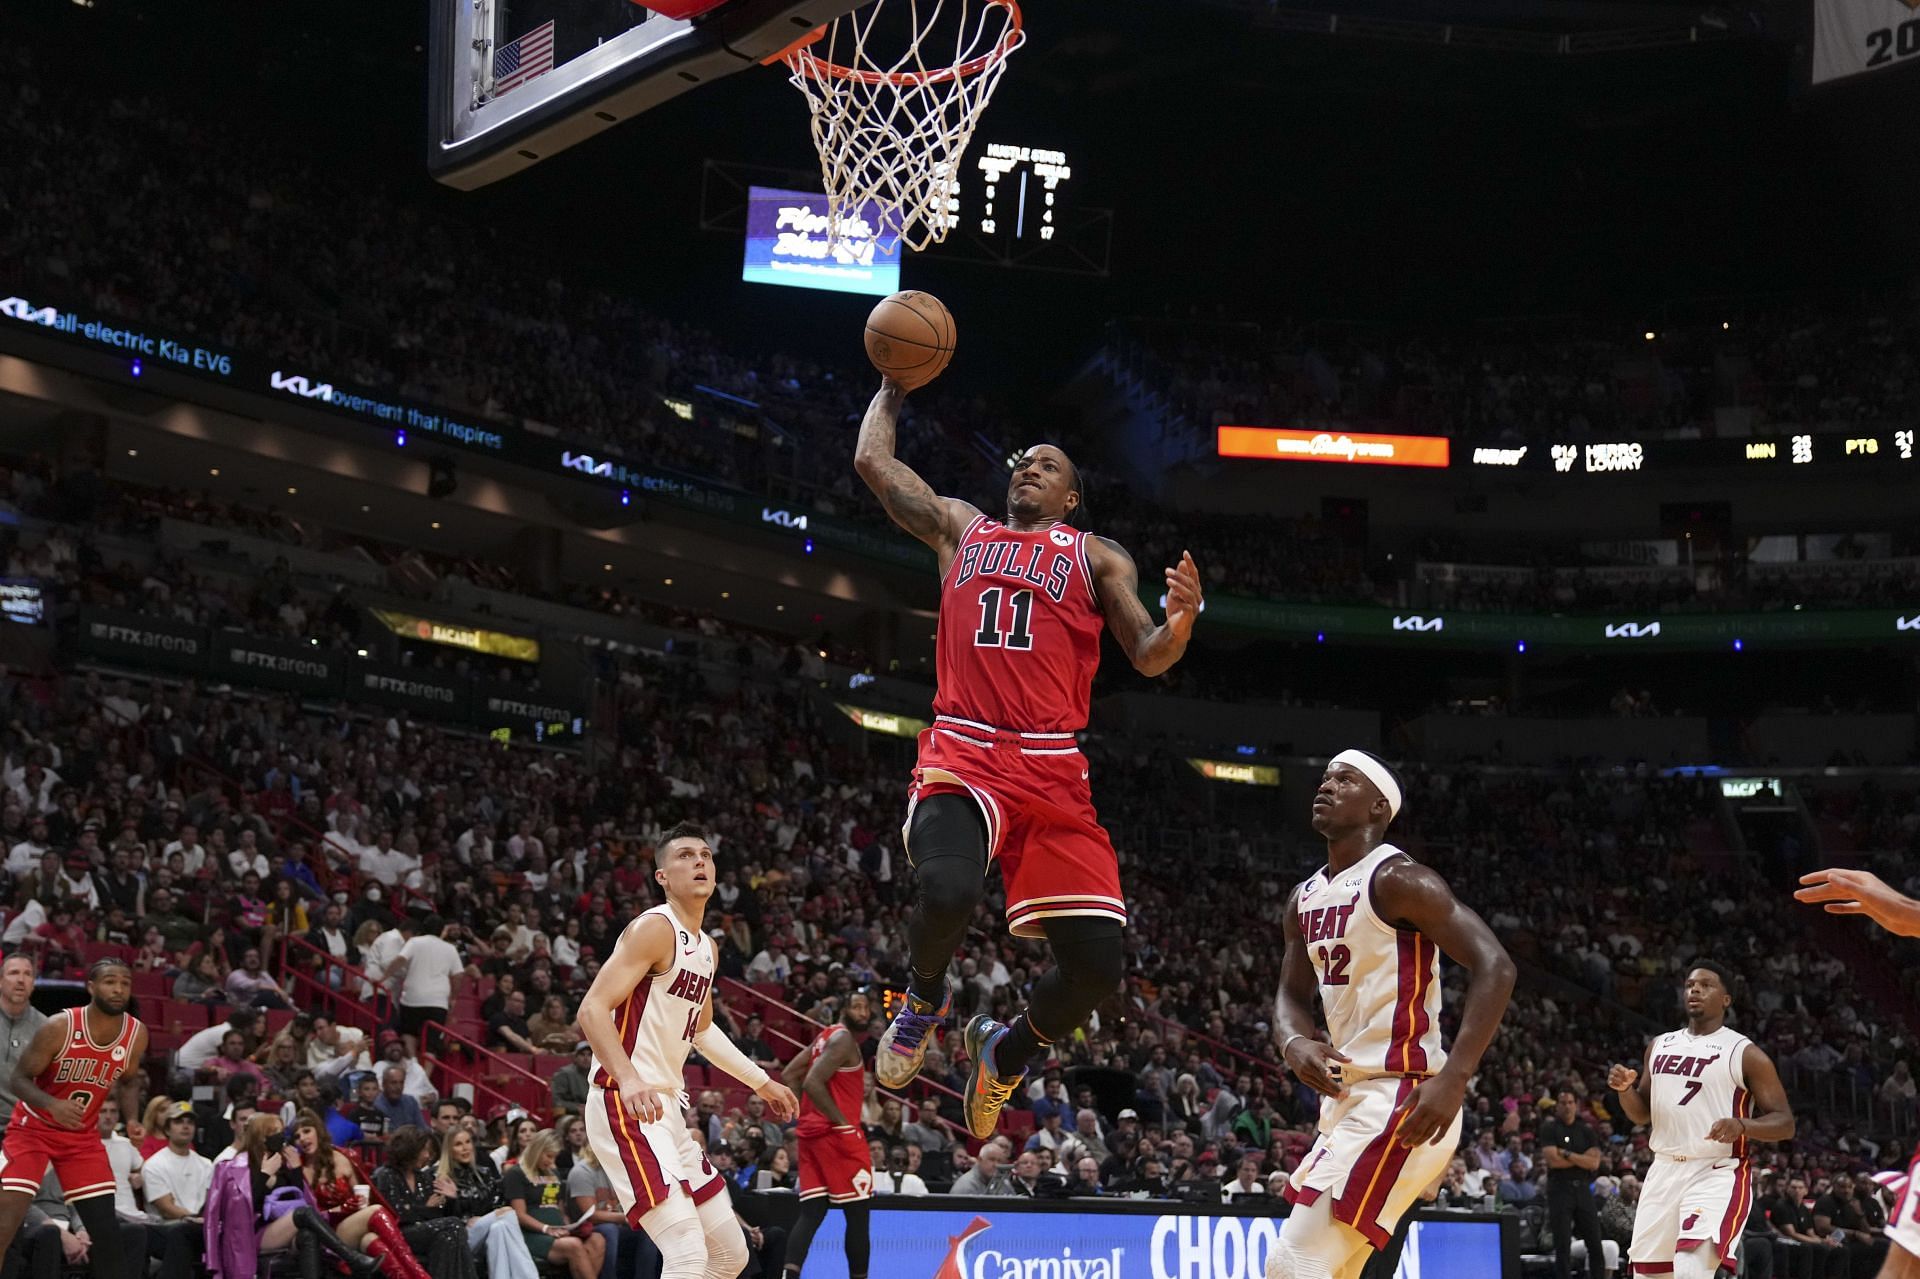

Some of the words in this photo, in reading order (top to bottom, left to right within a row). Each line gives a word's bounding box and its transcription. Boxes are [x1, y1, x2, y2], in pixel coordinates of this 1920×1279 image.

[158, 338, 189, 365] Kia
[193, 346, 232, 376] EV6
[407, 408, 440, 432] that
[443, 417, 504, 449] inspires
[1586, 443, 1642, 458] HERRO
[1746, 443, 1775, 458] MIN
[1895, 430, 1913, 446] 21
[1586, 456, 1643, 471] LOWRY
[1901, 444, 1912, 458] 2
[955, 542, 1073, 603] BULLS
[974, 587, 1033, 650] 11
[1298, 891, 1360, 944] HEAT
[667, 968, 712, 1006] HEAT
[1653, 1053, 1720, 1078] HEAT
[1678, 1081, 1702, 1106] 7
[974, 1247, 1121, 1279] Carnival
[1150, 1215, 1289, 1279] CHOO
